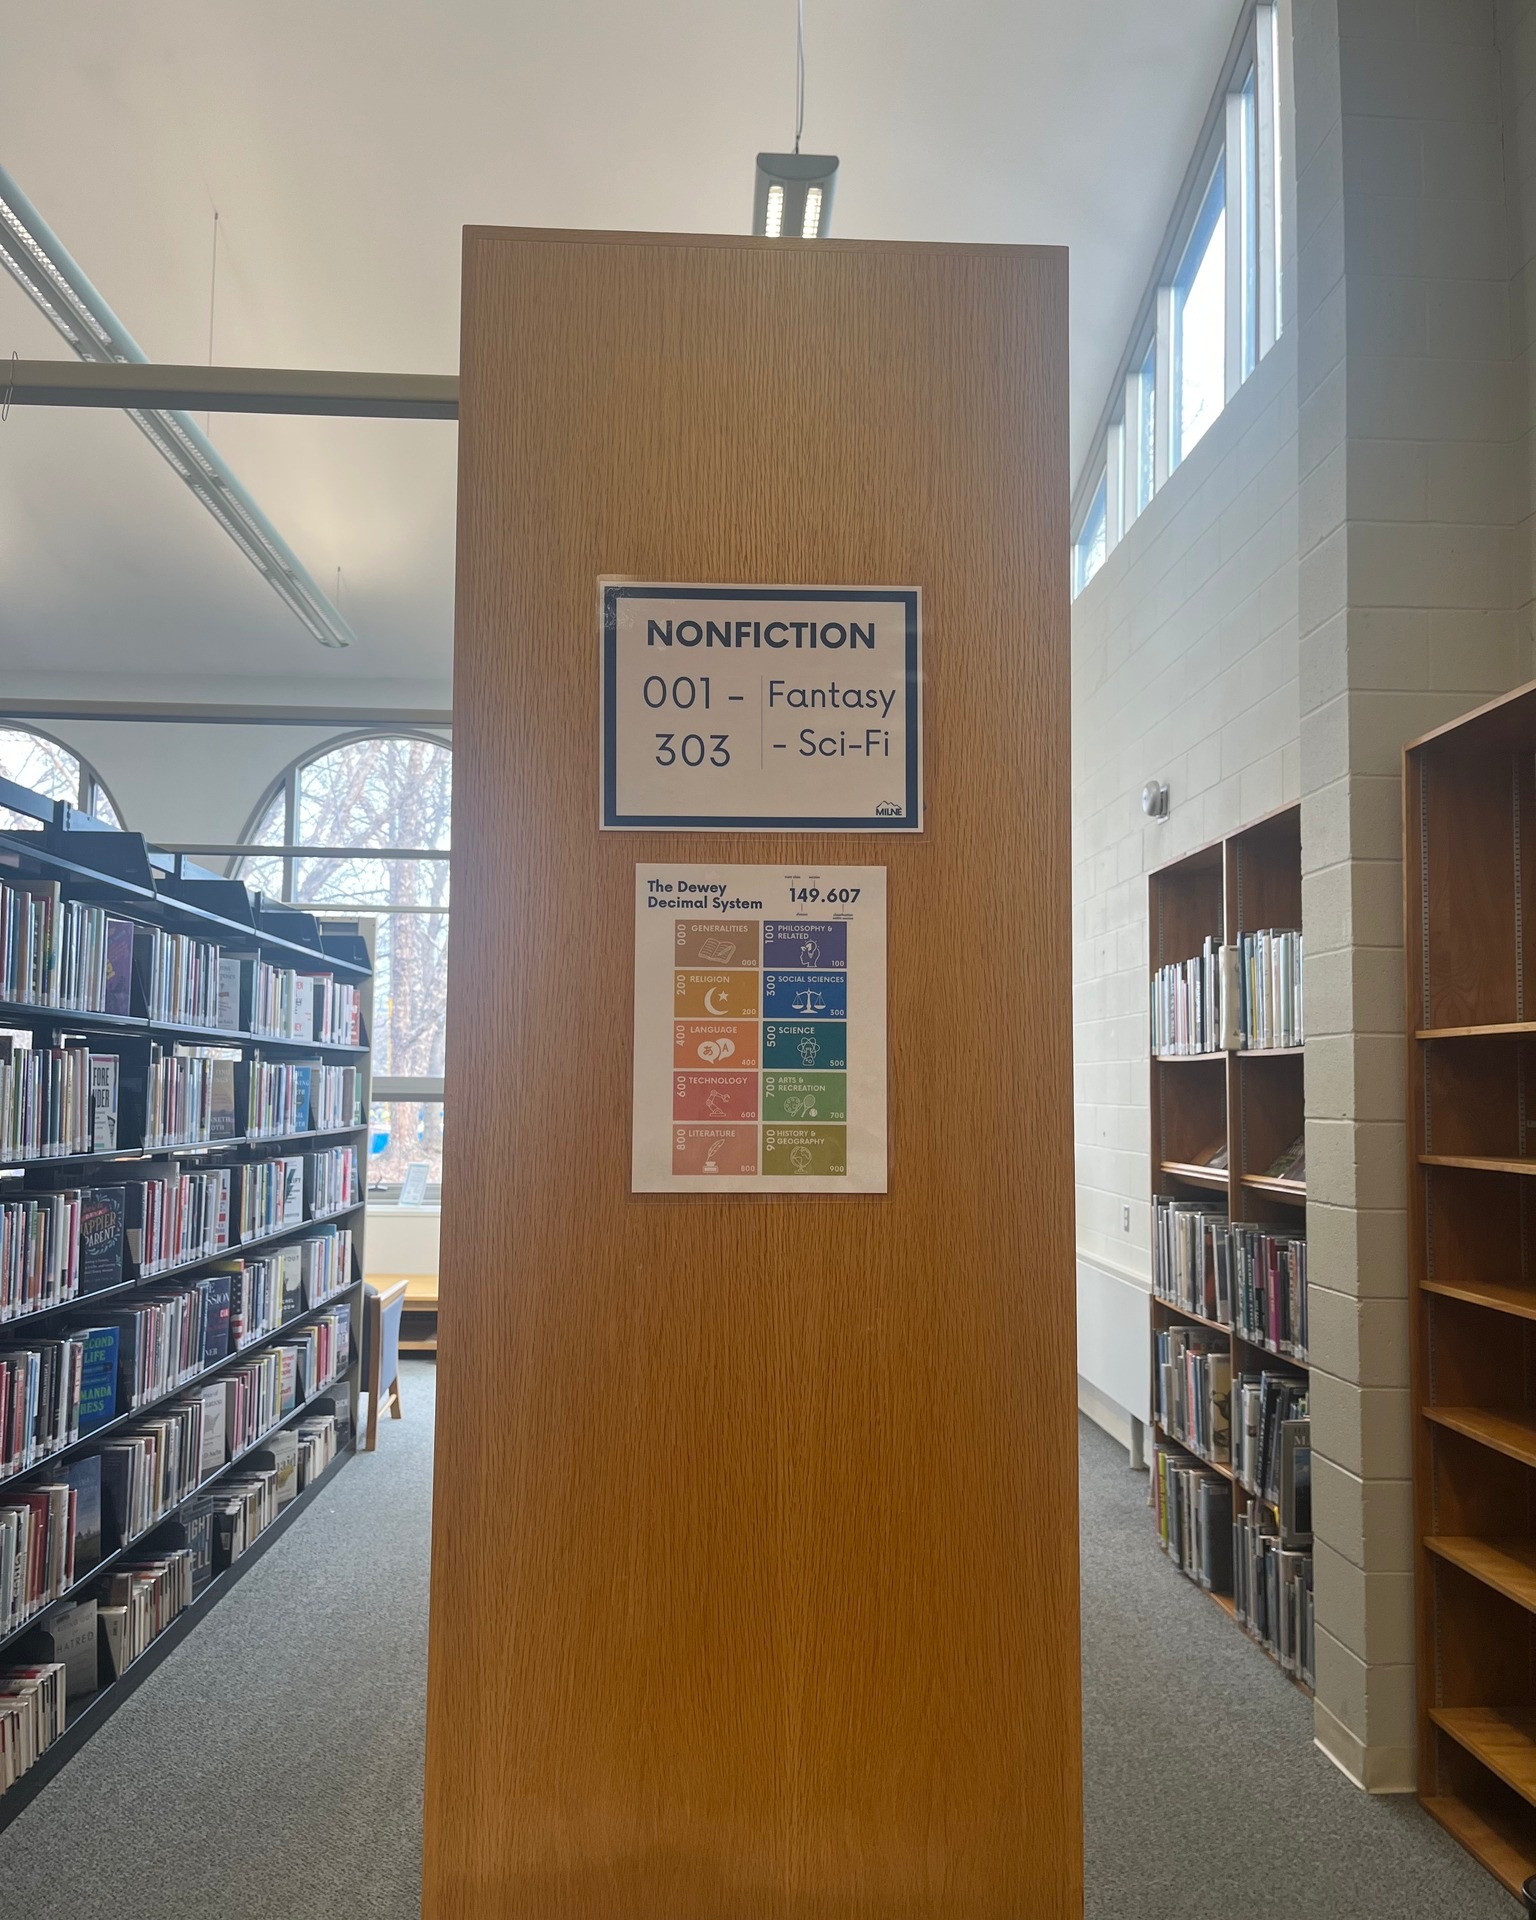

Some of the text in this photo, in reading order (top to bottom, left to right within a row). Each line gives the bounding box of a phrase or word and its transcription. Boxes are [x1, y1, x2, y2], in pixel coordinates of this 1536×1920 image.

[647, 619, 876, 650] NONFICTION
[643, 675, 711, 710] 001
[769, 680, 896, 719] Fantasy
[799, 728, 890, 757] Sci-Fi
[655, 733, 731, 768] 303
[875, 807, 903, 817] MILNE
[647, 879, 727, 896] The Dewey
[789, 887, 861, 904] 149.607
[648, 895, 763, 913] Decimal System
[691, 924, 749, 934] GENERALITIES
[777, 924, 824, 933] PHILOSOPHY
[765, 924, 774, 945] 100
[777, 932, 809, 941] RELATED
[741, 959, 757, 967] 000
[831, 960, 845, 968] 100
[690, 975, 730, 984] RELIGION
[778, 975, 845, 984] SOCIAL SCIENCES
[676, 974, 686, 996] 200
[766, 975, 776, 996] 300
[742, 1008, 757, 1016] 200
[690, 1026, 738, 1034] LANGUAGE
[778, 1026, 815, 1035] SCIENCE
[676, 1024, 686, 1047] 400
[766, 1025, 776, 1047] 500
[741, 1059, 756, 1067] 400
[829, 1059, 845, 1067] 500
[92, 1067, 110, 1087] FORE
[688, 1076, 748, 1085] TECHNOLOGY
[778, 1076, 797, 1085] ARTS
[676, 1075, 687, 1098] 600
[765, 1077, 775, 1098] 700
[778, 1084, 826, 1093] RECREATION
[740, 1111, 756, 1119] 600
[688, 1129, 736, 1138] LITERATURE
[776, 1130, 808, 1138] HISTORY
[766, 1129, 776, 1152] 900
[776, 1138, 825, 1146] GEOGRAPHY
[740, 1165, 756, 1173] 800
[829, 1165, 845, 1173] 900
[83, 1335, 115, 1350] ECOND
[80, 1385, 113, 1400] MANDA
[56, 1631, 94, 1655] HATRED
